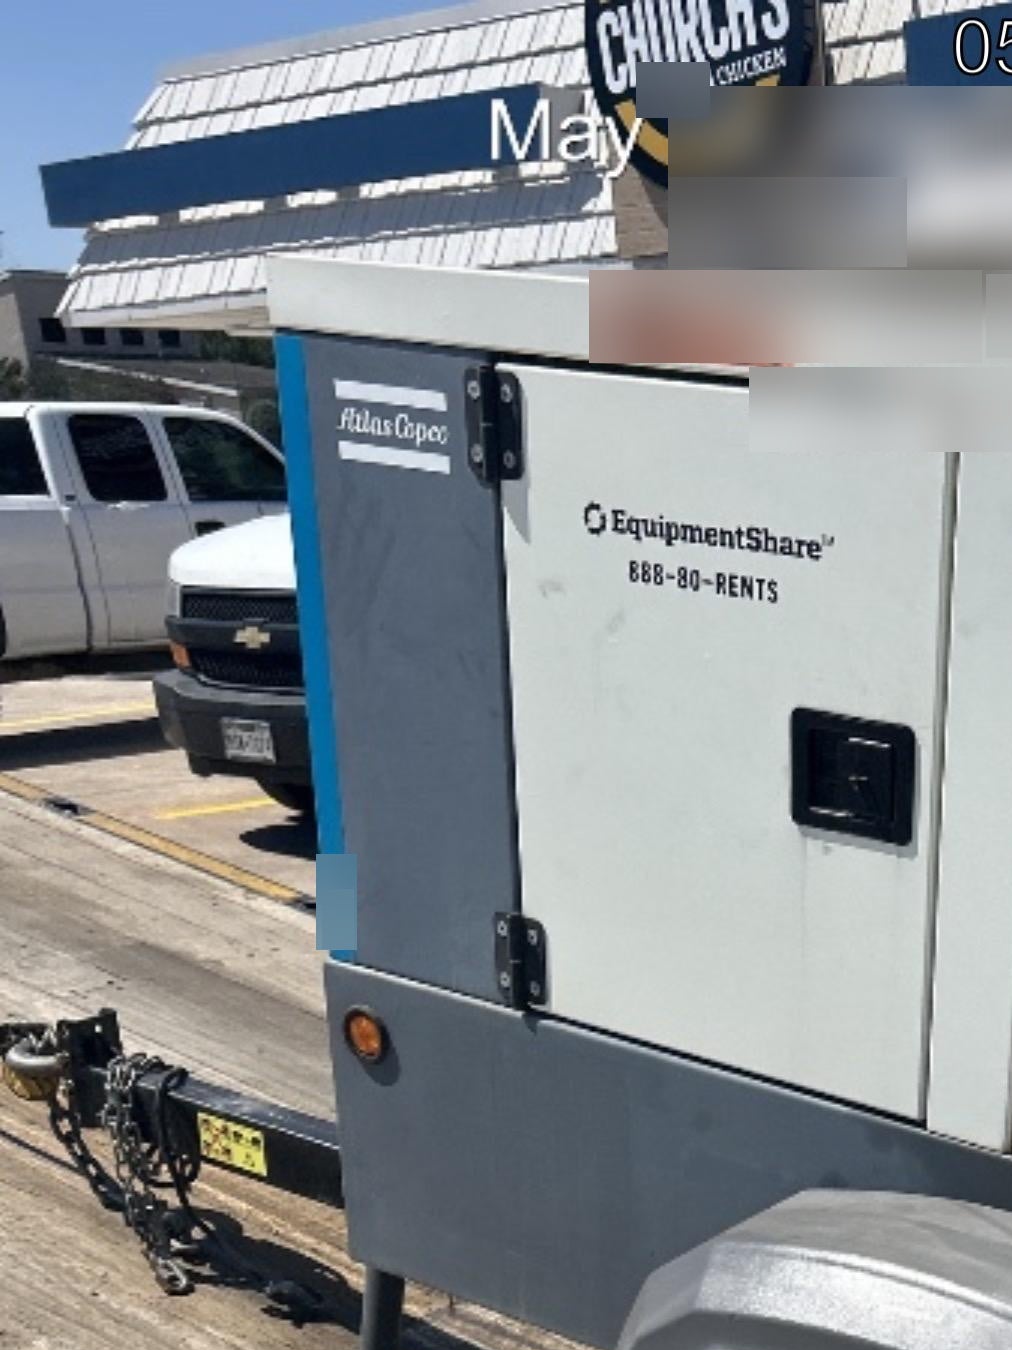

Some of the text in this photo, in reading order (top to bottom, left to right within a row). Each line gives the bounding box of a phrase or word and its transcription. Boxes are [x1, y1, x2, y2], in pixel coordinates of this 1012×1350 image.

[716, 47, 787, 86] CHICKEN
[336, 406, 449, 448] Atlas Copco
[628, 559, 779, 604] 888-80-RENTS
